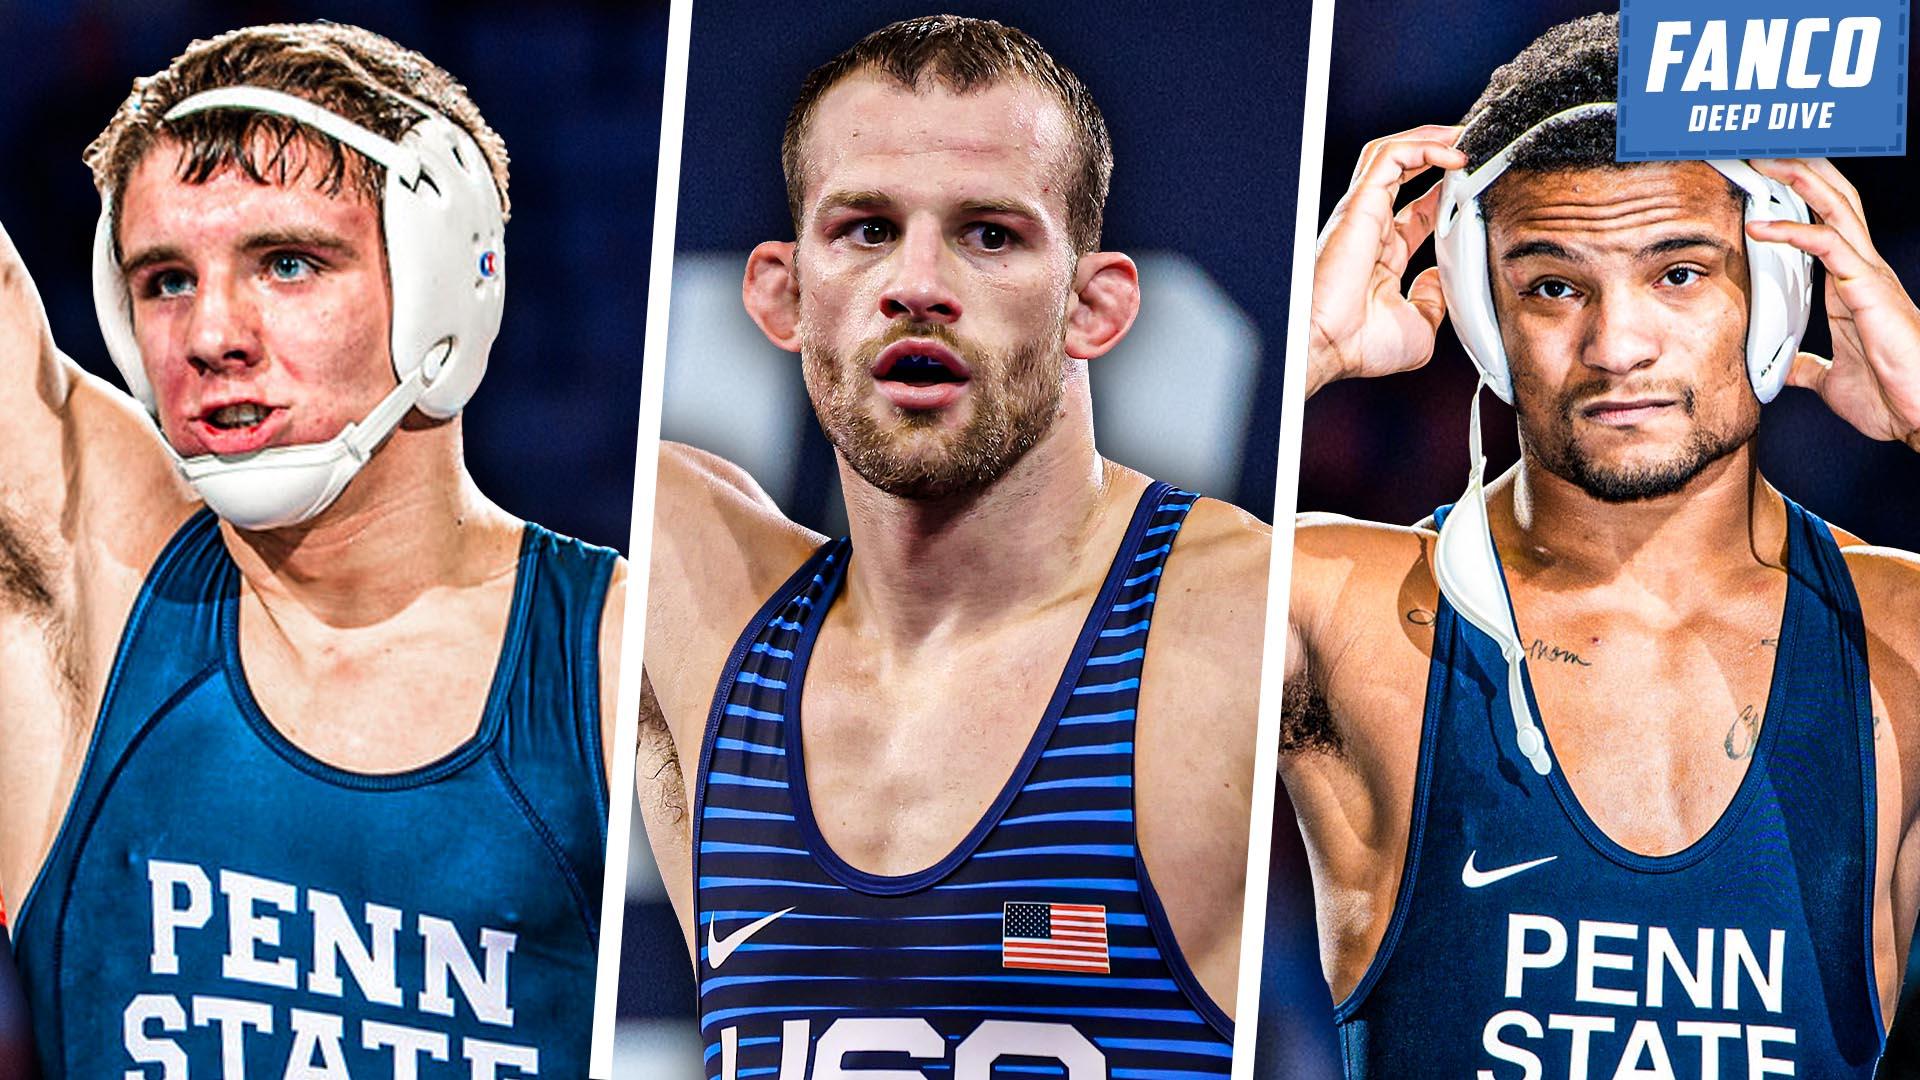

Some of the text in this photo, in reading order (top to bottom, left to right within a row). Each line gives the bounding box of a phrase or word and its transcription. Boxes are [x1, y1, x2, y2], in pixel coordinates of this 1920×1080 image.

[148, 859, 517, 1027] PENN
[1504, 913, 1786, 1013] PENN
[1476, 1010, 1797, 1080] STATE
